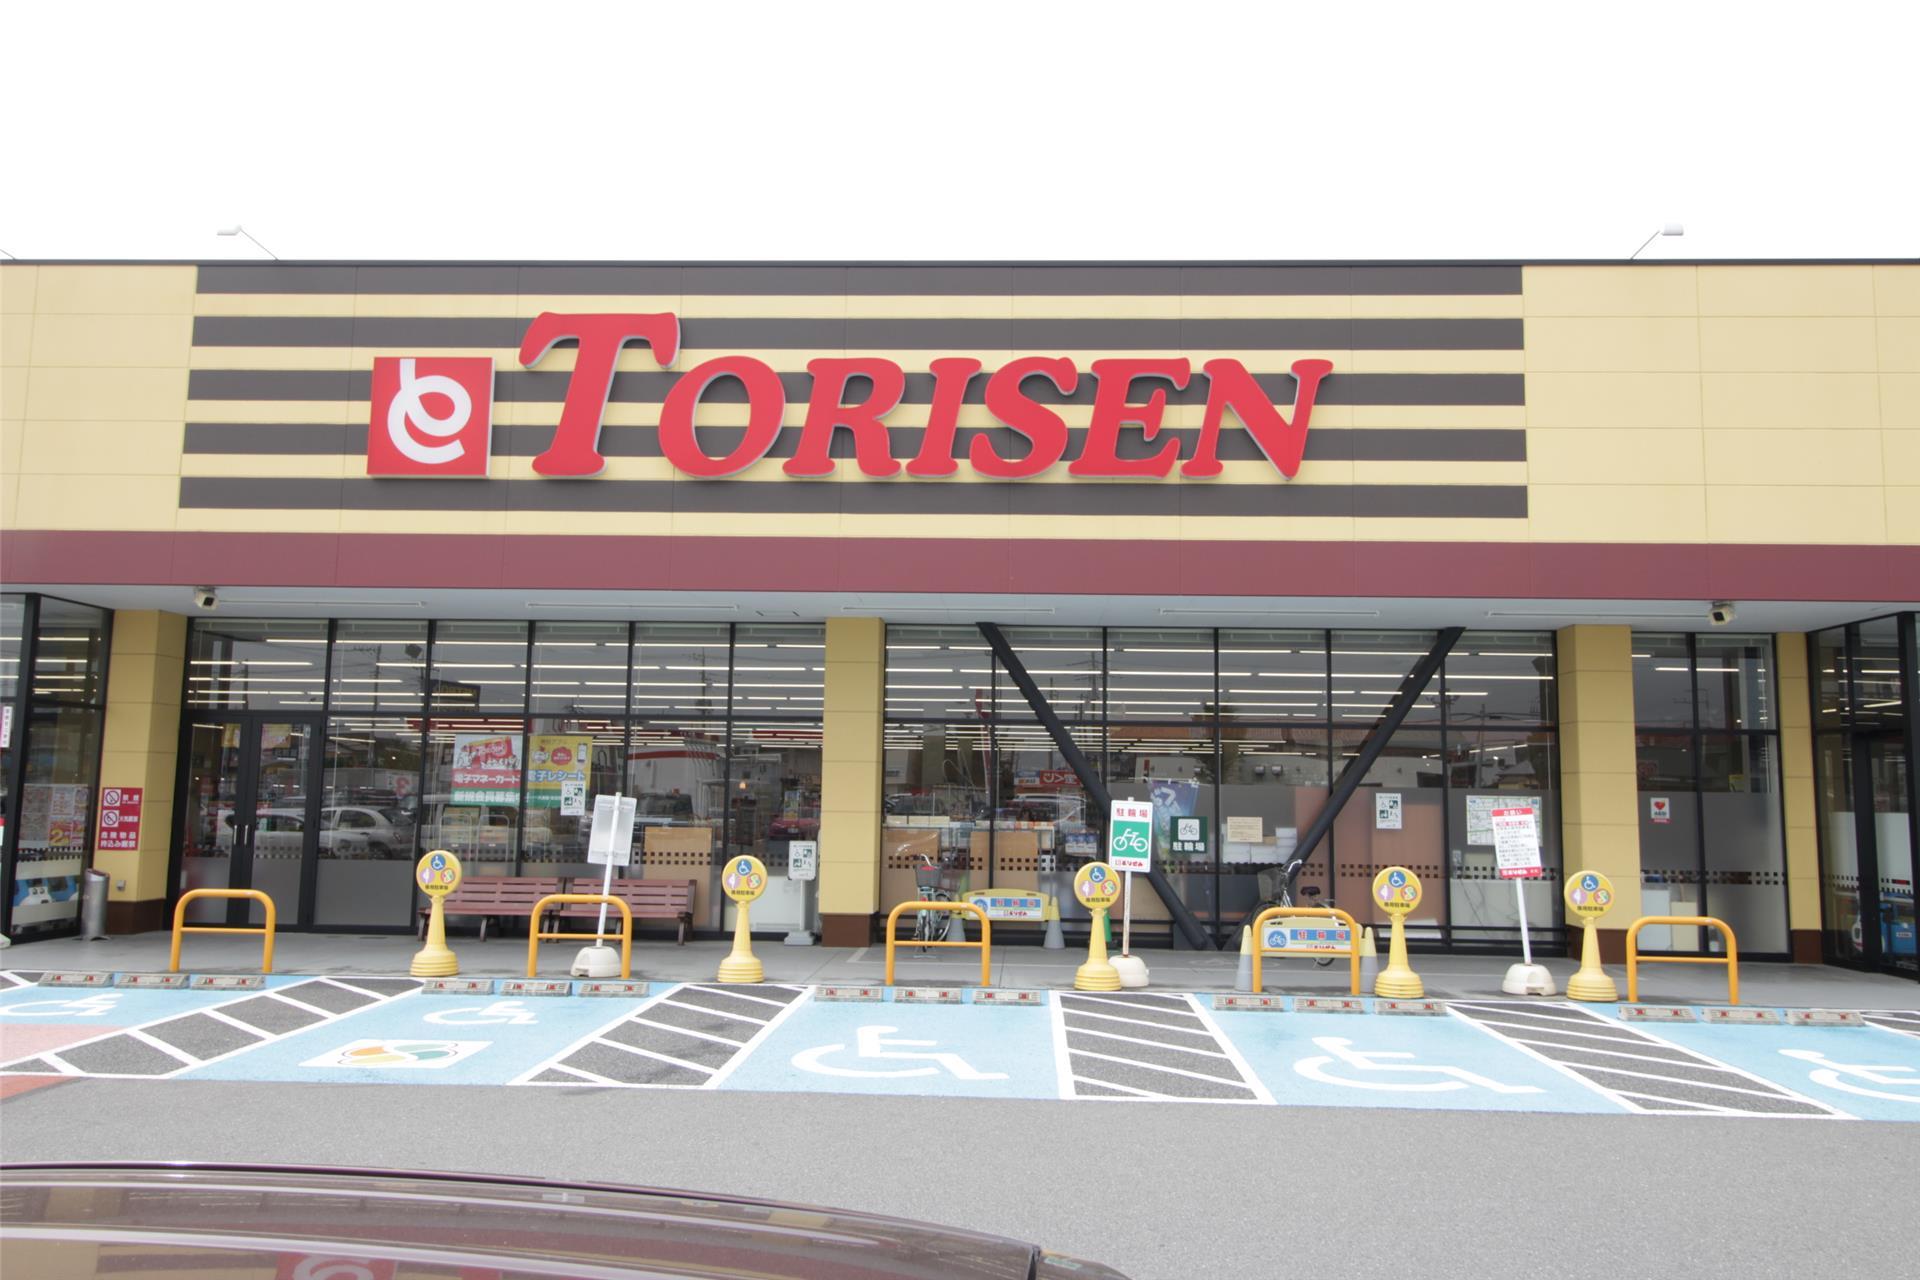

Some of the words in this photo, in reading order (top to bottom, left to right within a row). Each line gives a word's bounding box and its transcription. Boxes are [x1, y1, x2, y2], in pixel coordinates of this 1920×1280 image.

[518, 311, 1333, 481] TORISEN
[1116, 808, 1148, 818] 駐輪場
[1172, 841, 1205, 852] 駐輪場
[1297, 930, 1346, 940] 駐輪場
